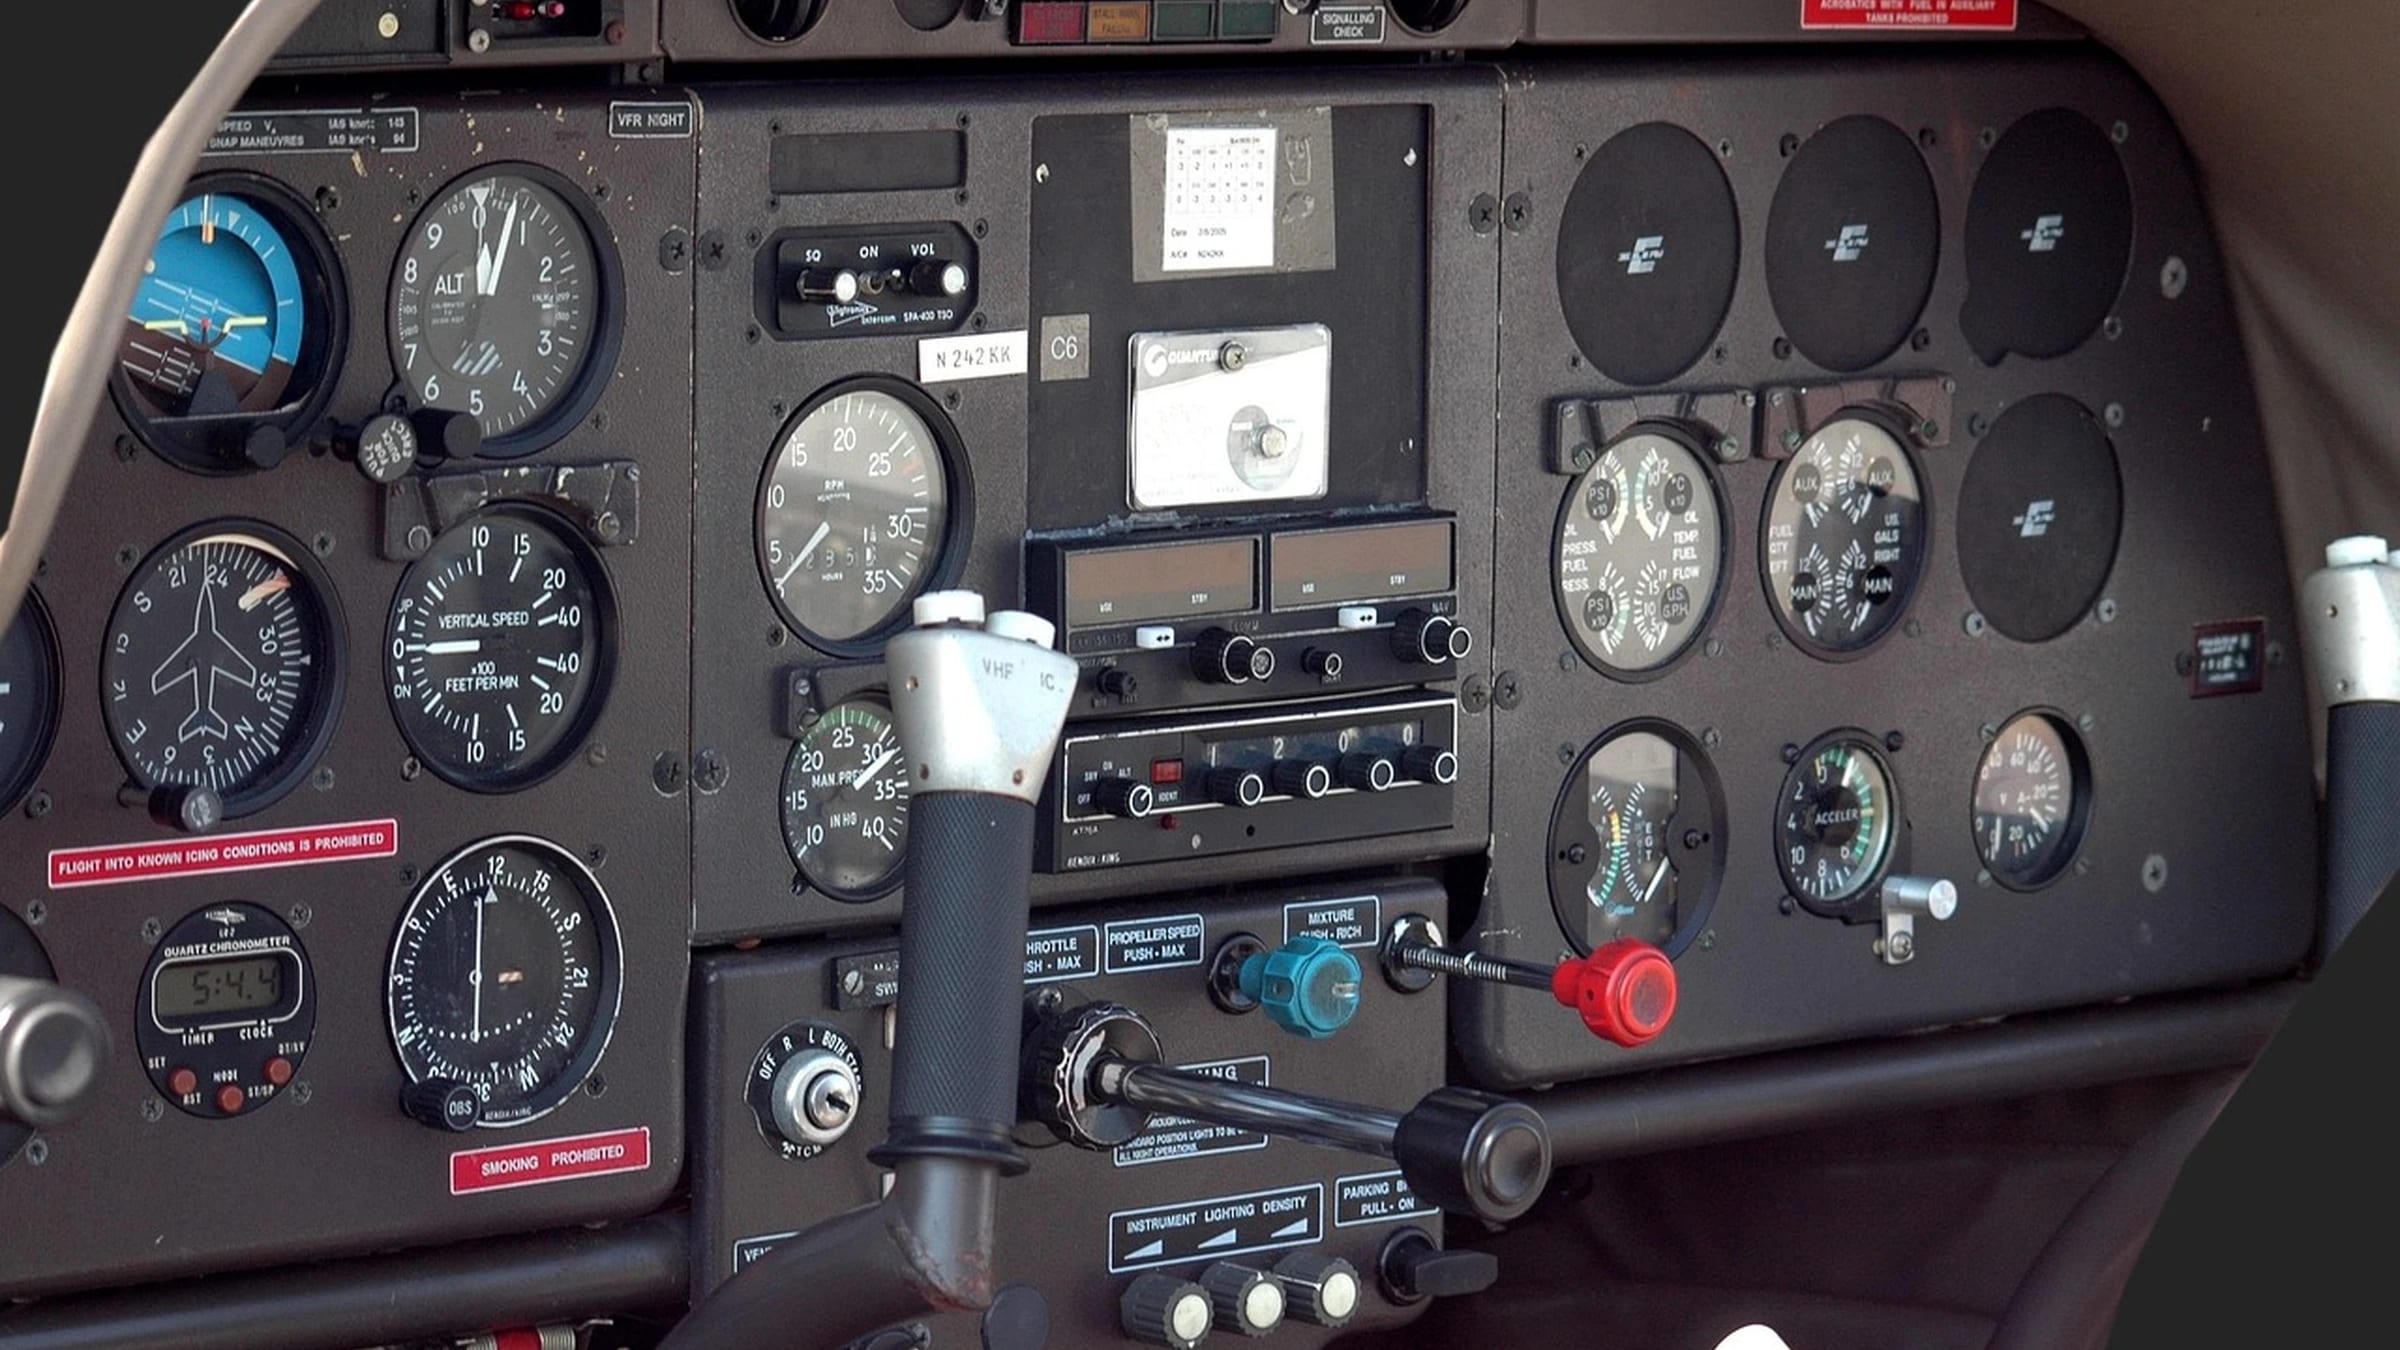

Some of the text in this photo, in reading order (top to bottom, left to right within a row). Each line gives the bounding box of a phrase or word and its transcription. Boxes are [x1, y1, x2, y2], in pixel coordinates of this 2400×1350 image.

[1909, 0, 1933, 11] FUEL
[1322, 11, 1376, 26] SIGNALLING
[1865, 12, 1949, 24] TANKS PROHIBITED
[1333, 25, 1364, 38] CHECK
[617, 111, 685, 127] VFR NIGHT
[427, 223, 443, 250] 9
[805, 248, 822, 263] SQ
[859, 246, 879, 259] ON
[911, 242, 935, 257] VOL
[404, 257, 418, 284] 8
[539, 256, 553, 283] 2
[434, 271, 465, 296] ALT
[537, 330, 552, 356] 3
[1050, 336, 1078, 361] C6
[404, 343, 418, 370] 7
[935, 352, 947, 369] N
[424, 375, 440, 401] 6
[512, 370, 528, 396] 4
[469, 390, 484, 416] 5
[832, 427, 856, 452] 20
[791, 442, 808, 468] 15
[868, 452, 892, 477] 25
[824, 479, 845, 491] RPM
[1793, 477, 1818, 493] AUX
[1869, 471, 1893, 486] AUX
[767, 484, 785, 509] 10
[1588, 486, 1611, 501] PSI
[472, 526, 490, 548] 10
[886, 514, 912, 539] 30
[1769, 524, 1794, 539] FUEL
[1873, 529, 1899, 544] GALS
[514, 533, 531, 555] 15
[769, 540, 783, 565] 5
[1672, 548, 1697, 562] FUEL
[1769, 541, 1789, 554] QTY
[1562, 560, 1588, 573] FUEL
[1769, 559, 1789, 574] EFT
[1873, 548, 1900, 563] RIGHT
[167, 565, 187, 589] 21
[207, 564, 229, 589] 24
[543, 567, 566, 590] 20
[862, 569, 887, 594] 35
[1673, 565, 1699, 580] FLOW
[1790, 584, 1818, 601] MAIN
[1864, 578, 1893, 595] MAIN
[133, 590, 152, 614] S
[1587, 598, 1611, 613] PSI
[438, 610, 530, 630] VERTICAL SPEED
[558, 605, 581, 627] 40
[258, 624, 278, 656] 30
[392, 639, 405, 660] 0
[557, 652, 580, 674] 40
[981, 657, 1014, 680] VHF
[256, 672, 278, 703] 33
[393, 684, 412, 699] DN
[445, 677, 476, 693] FEET
[476, 675, 500, 692] PER
[540, 692, 564, 714] 20
[125, 718, 147, 745] E
[234, 715, 255, 741] N
[832, 727, 854, 749] 25
[466, 741, 485, 763] 10
[508, 730, 526, 752] 15
[1273, 737, 1285, 760] 2
[202, 744, 216, 765] 3
[801, 750, 824, 772] 20
[861, 743, 883, 765] 30
[791, 790, 808, 811] 15
[874, 779, 896, 801] 35
[830, 813, 842, 828] IN
[861, 816, 885, 838] 40
[1814, 808, 1859, 825] ACCELER
[806, 824, 824, 847] 10
[58, 832, 385, 877] FLIGHT INTO KNOWN ICING CONDITIONS IS PROHIBITED
[487, 856, 506, 875] 12
[1790, 845, 1805, 865] 10
[1817, 858, 1827, 878] 8
[532, 869, 551, 893] 15
[563, 911, 582, 932] S
[1308, 908, 1355, 925] MIXTURE
[1109, 923, 1200, 945] PROPELLER SPEED
[1336, 925, 1362, 940] RICH
[164, 935, 291, 958] QUARTZ CHRONOMETER
[1026, 937, 1078, 956] HROTTLE
[1123, 943, 1186, 962] PUSH MAX
[1057, 955, 1082, 970] MAX
[573, 967, 590, 989] 21
[182, 1031, 215, 1047] TIMER
[239, 1025, 275, 1041] CLOCK
[555, 1025, 576, 1047] 24
[783, 1035, 793, 1051] R
[808, 1027, 815, 1044] L
[821, 1030, 849, 1057] BOTH
[148, 1056, 167, 1069] SET
[758, 1054, 778, 1081] OFF
[213, 1069, 239, 1083] MODE
[520, 1065, 541, 1092] W
[449, 1099, 472, 1116] OBS
[481, 1143, 625, 1177] SMOKING PROHIBITED
[1343, 1181, 1390, 1200] PARKING
[1126, 1195, 1308, 1234] INSTRUMENT LIGHTING DENSITY
[1361, 1197, 1415, 1217] PULL ON
